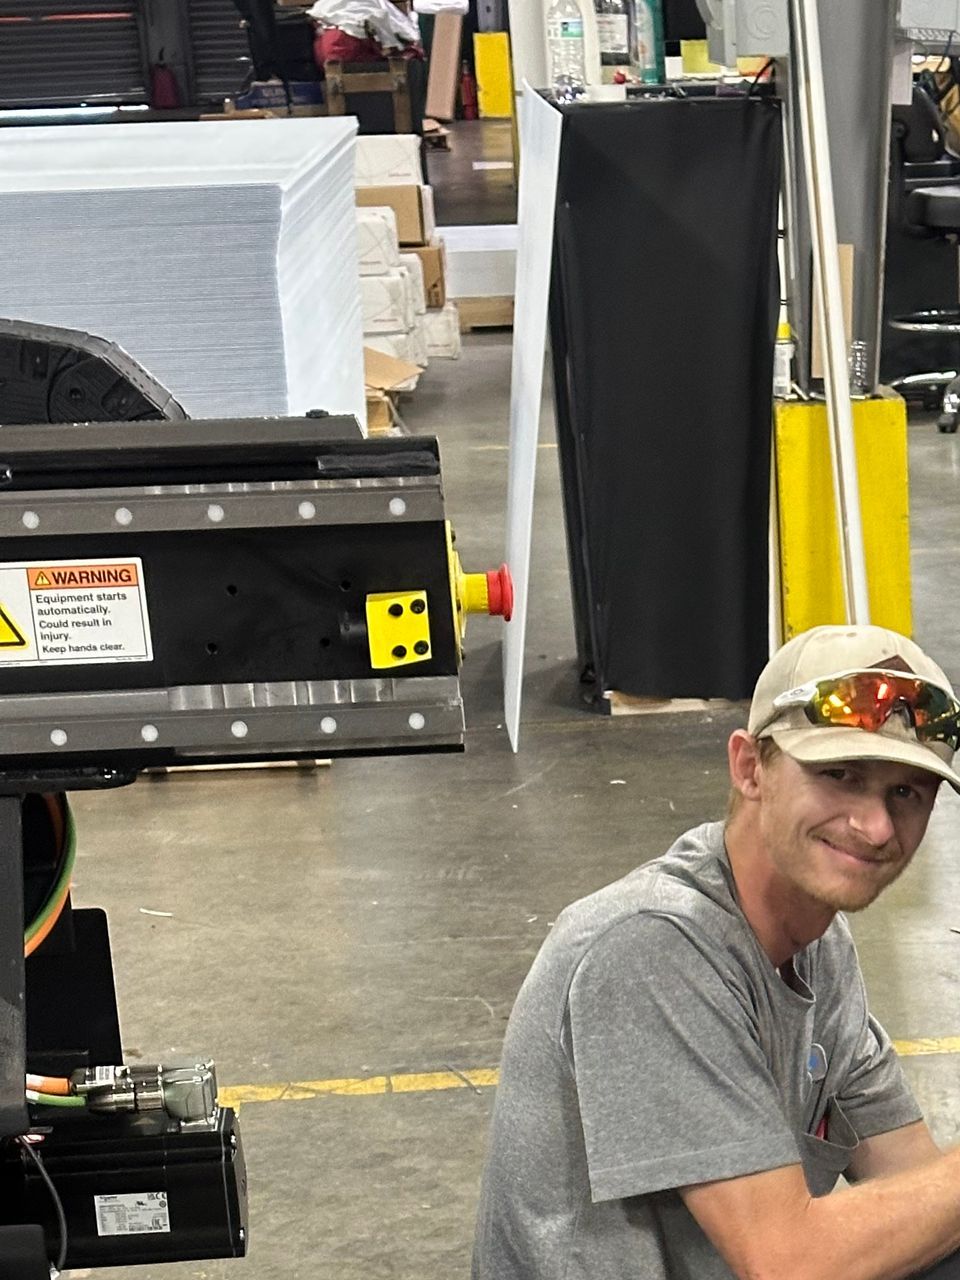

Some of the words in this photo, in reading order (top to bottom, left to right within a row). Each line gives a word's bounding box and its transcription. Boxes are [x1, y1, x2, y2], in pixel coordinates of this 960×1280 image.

[51, 569, 132, 585] WARNING
[35, 593, 94, 605] Equipment
[96, 591, 127, 602] starts
[37, 605, 112, 617] automatically.
[39, 619, 69, 629] Could
[71, 618, 99, 628] result
[102, 618, 112, 627] in
[40, 632, 72, 642] injury.
[42, 645, 67, 655] Keep
[68, 643, 97, 653] hands
[100, 643, 125, 652] clear.
